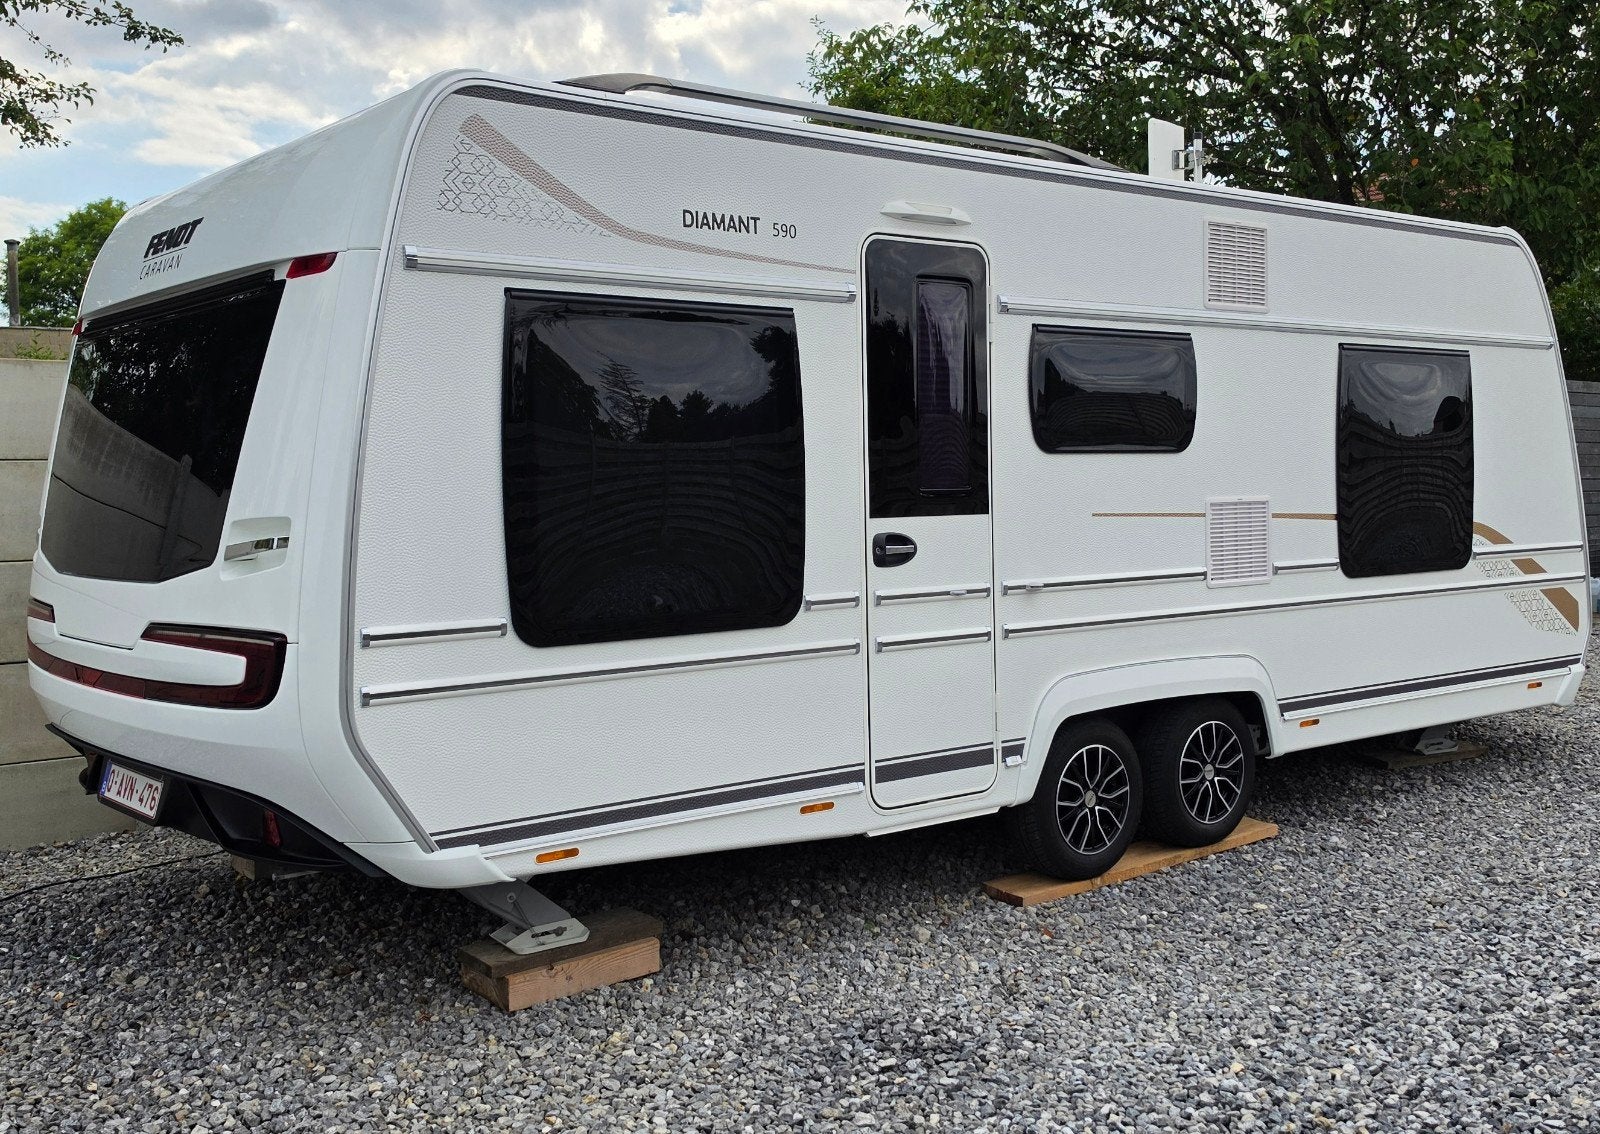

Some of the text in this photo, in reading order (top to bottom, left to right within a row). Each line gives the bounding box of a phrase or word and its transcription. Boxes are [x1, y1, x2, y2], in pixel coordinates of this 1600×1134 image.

[143, 216, 205, 259] FENDT
[682, 209, 797, 239] DIAMANT 590
[139, 253, 184, 280] CARAVAN
